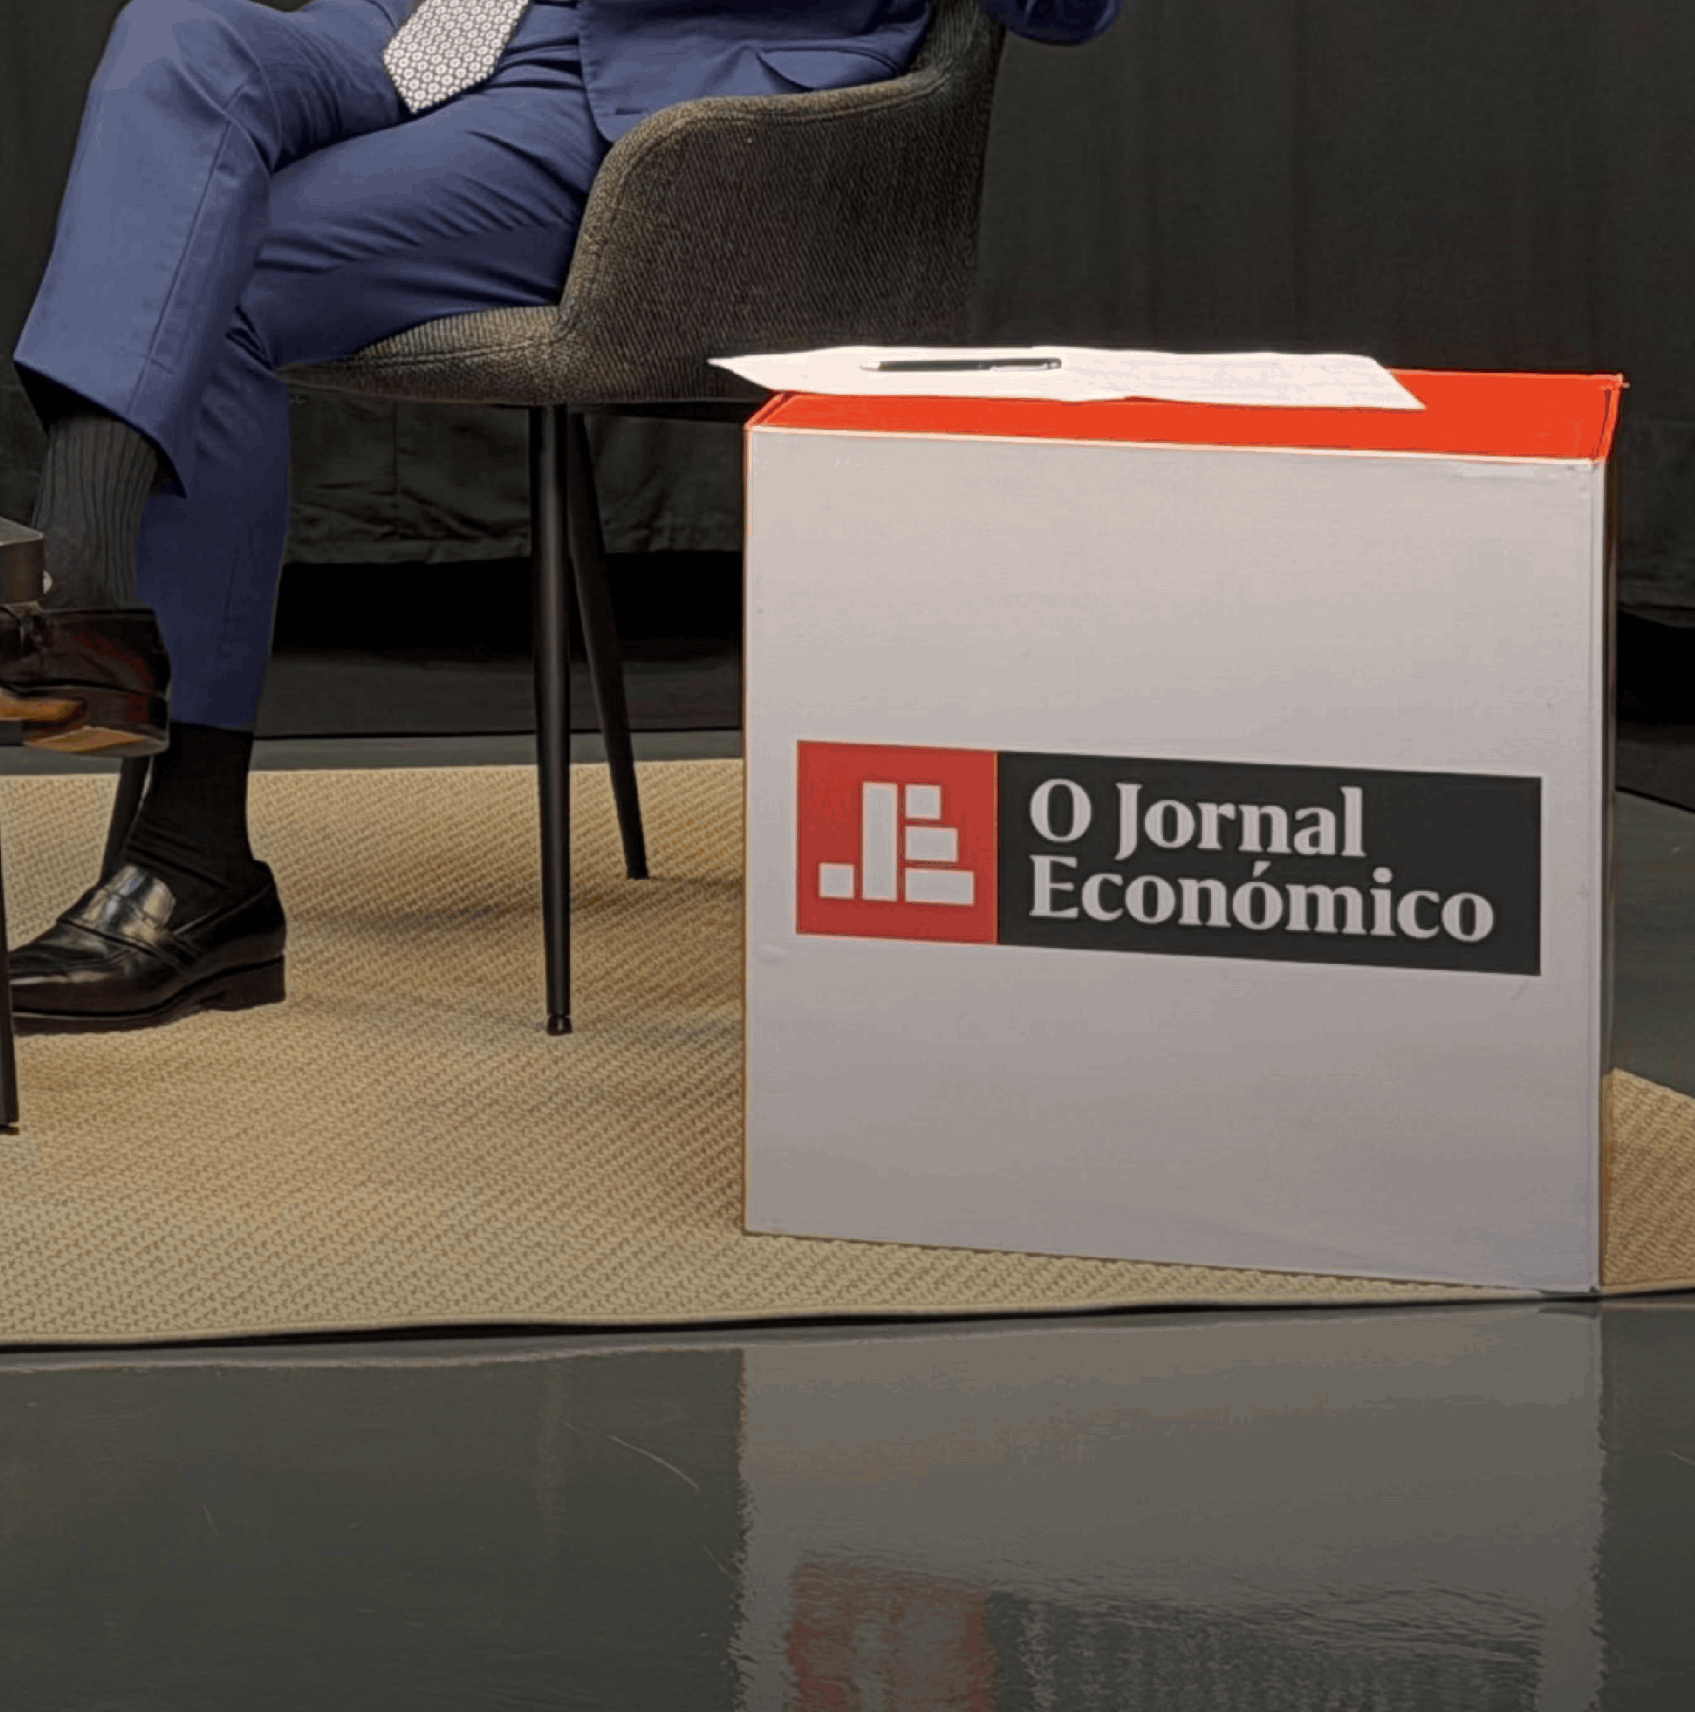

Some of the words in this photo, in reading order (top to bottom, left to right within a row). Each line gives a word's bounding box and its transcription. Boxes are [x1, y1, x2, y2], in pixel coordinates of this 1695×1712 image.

[1029, 779, 1092, 843] O
[1114, 782, 1367, 861] Jornal
[1028, 854, 1495, 943] Económico
